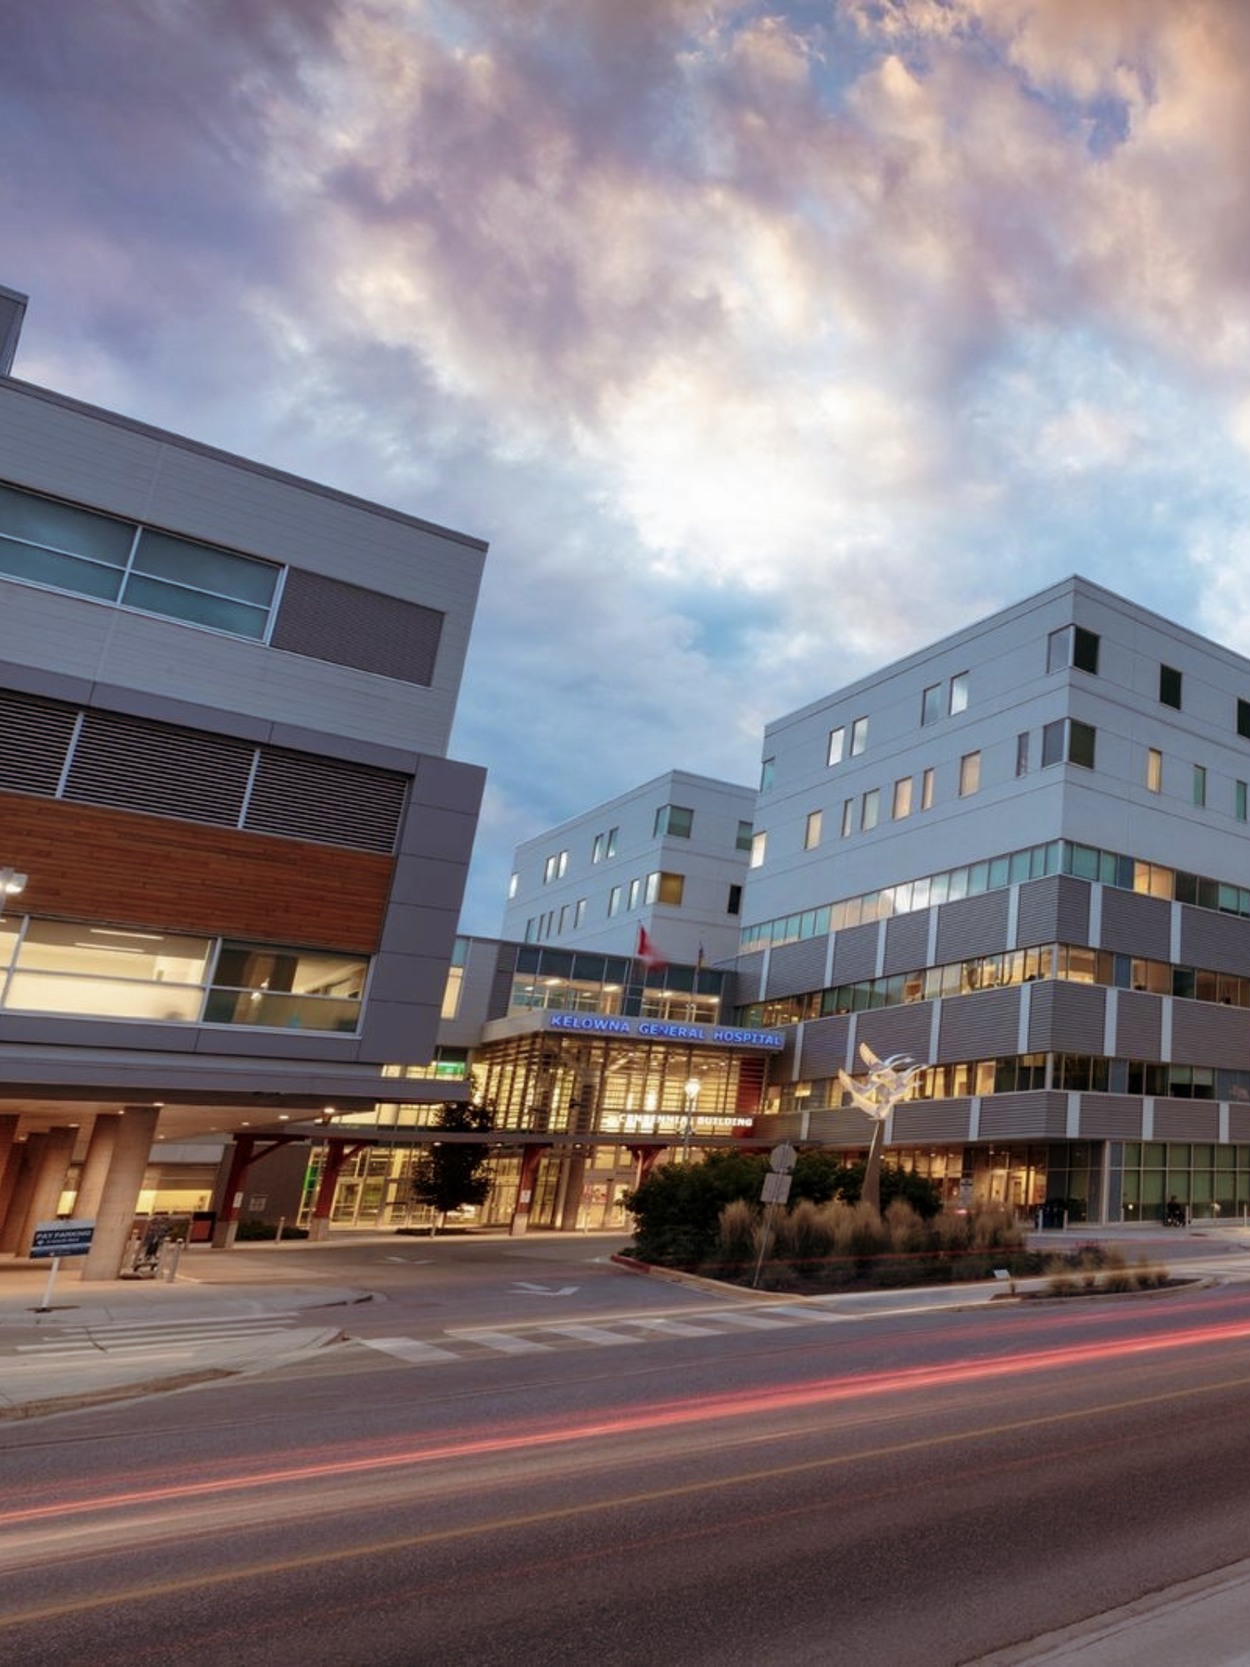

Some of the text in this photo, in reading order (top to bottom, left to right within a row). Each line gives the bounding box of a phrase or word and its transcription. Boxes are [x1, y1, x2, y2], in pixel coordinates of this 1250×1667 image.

[551, 1015, 780, 1046] KELOWNA GENERAL HOSPITAL
[697, 1116, 753, 1127] BUILDING
[54, 1231, 91, 1239] PARKING
